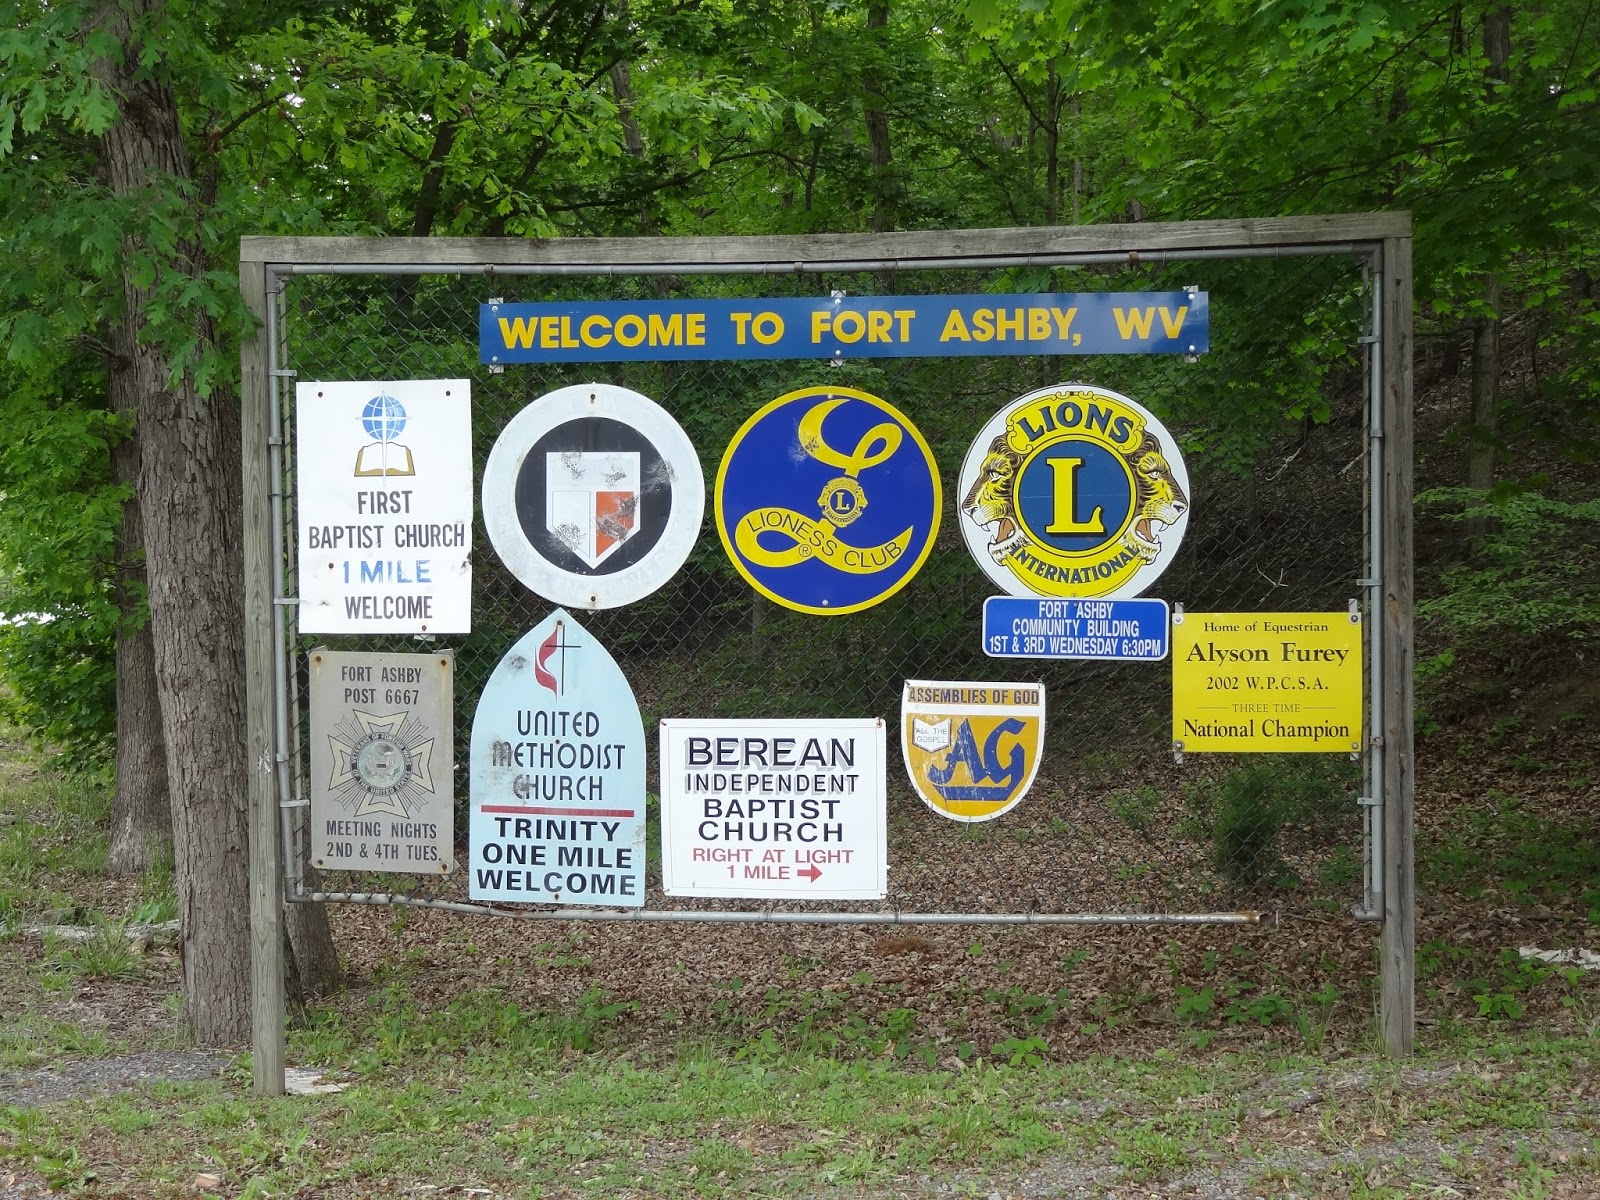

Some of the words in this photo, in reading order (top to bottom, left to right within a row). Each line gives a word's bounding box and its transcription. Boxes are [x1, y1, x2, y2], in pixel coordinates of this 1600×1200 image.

[498, 313, 706, 349] WELCOME
[730, 311, 785, 345] TO
[811, 310, 916, 344] FORT
[940, 307, 1082, 347] ASHBY,
[1112, 306, 1188, 340] WV
[1016, 402, 1134, 443] LIONS
[357, 490, 413, 515] FIRST
[835, 492, 850, 511] L
[1045, 457, 1105, 535] L
[309, 525, 384, 549] BAPTIST
[395, 524, 465, 548] CHURCH
[747, 511, 838, 557] LIONESS
[844, 541, 902, 568] CLUB
[343, 560, 350, 584] 1
[360, 559, 432, 584] MILE
[1009, 547, 1140, 585] INTERNATIONAL
[344, 595, 433, 620] WELCOME
[1038, 600, 1069, 618] FORT
[1076, 602, 1114, 619] ASHBY
[1012, 619, 1079, 636] COMMUNITY
[1087, 620, 1139, 637] BUILDING
[1204, 622, 1240, 632] Home
[1245, 621, 1258, 632] of
[1263, 621, 1329, 634] Equestrian
[989, 636, 1009, 653] 1ST
[1012, 638, 1020, 653] &
[1023, 638, 1046, 654] 3RD
[1050, 638, 1119, 656] WEDNESDAY
[1122, 640, 1161, 656] 6:30PM
[1185, 642, 1270, 666] Alyson
[1280, 642, 1350, 666] Furey
[341, 666, 373, 682] FORT
[381, 667, 422, 683] ASHBY
[1206, 676, 1239, 690] 2002
[1246, 676, 1329, 690] W.P.C.S.A.
[344, 688, 376, 704] POST
[385, 689, 420, 705] 6667
[909, 688, 987, 704] ASSEMBLIES
[992, 689, 1009, 704] OF
[1013, 690, 1039, 705] GOD
[1232, 704, 1269, 713] THREE
[1274, 704, 1301, 713] TIME
[517, 710, 600, 737] UNITED
[1183, 718, 1254, 738] National
[1261, 718, 1350, 742] Champion
[492, 741, 626, 770] METHODIST
[685, 737, 856, 769] BEREAN
[513, 774, 603, 801] CHURCH
[686, 773, 859, 793] INDEPENDENT
[704, 799, 841, 819] BAPTIST
[326, 820, 381, 837] MEETING
[391, 823, 437, 839] NIGHTS
[494, 816, 621, 842] TRINITY
[698, 821, 843, 842] CHURCH
[326, 842, 353, 858] 2ND
[359, 844, 369, 859] &
[375, 844, 399, 860] 4TH
[406, 845, 442, 862] TUES.
[482, 843, 546, 866] ONE
[558, 847, 632, 869] MILE
[693, 848, 753, 862] RIGHT
[762, 849, 785, 863] AT
[794, 849, 854, 864] LIGHT
[476, 868, 636, 896] WELCOME
[727, 865, 735, 879] 1
[744, 865, 790, 880] MILE
